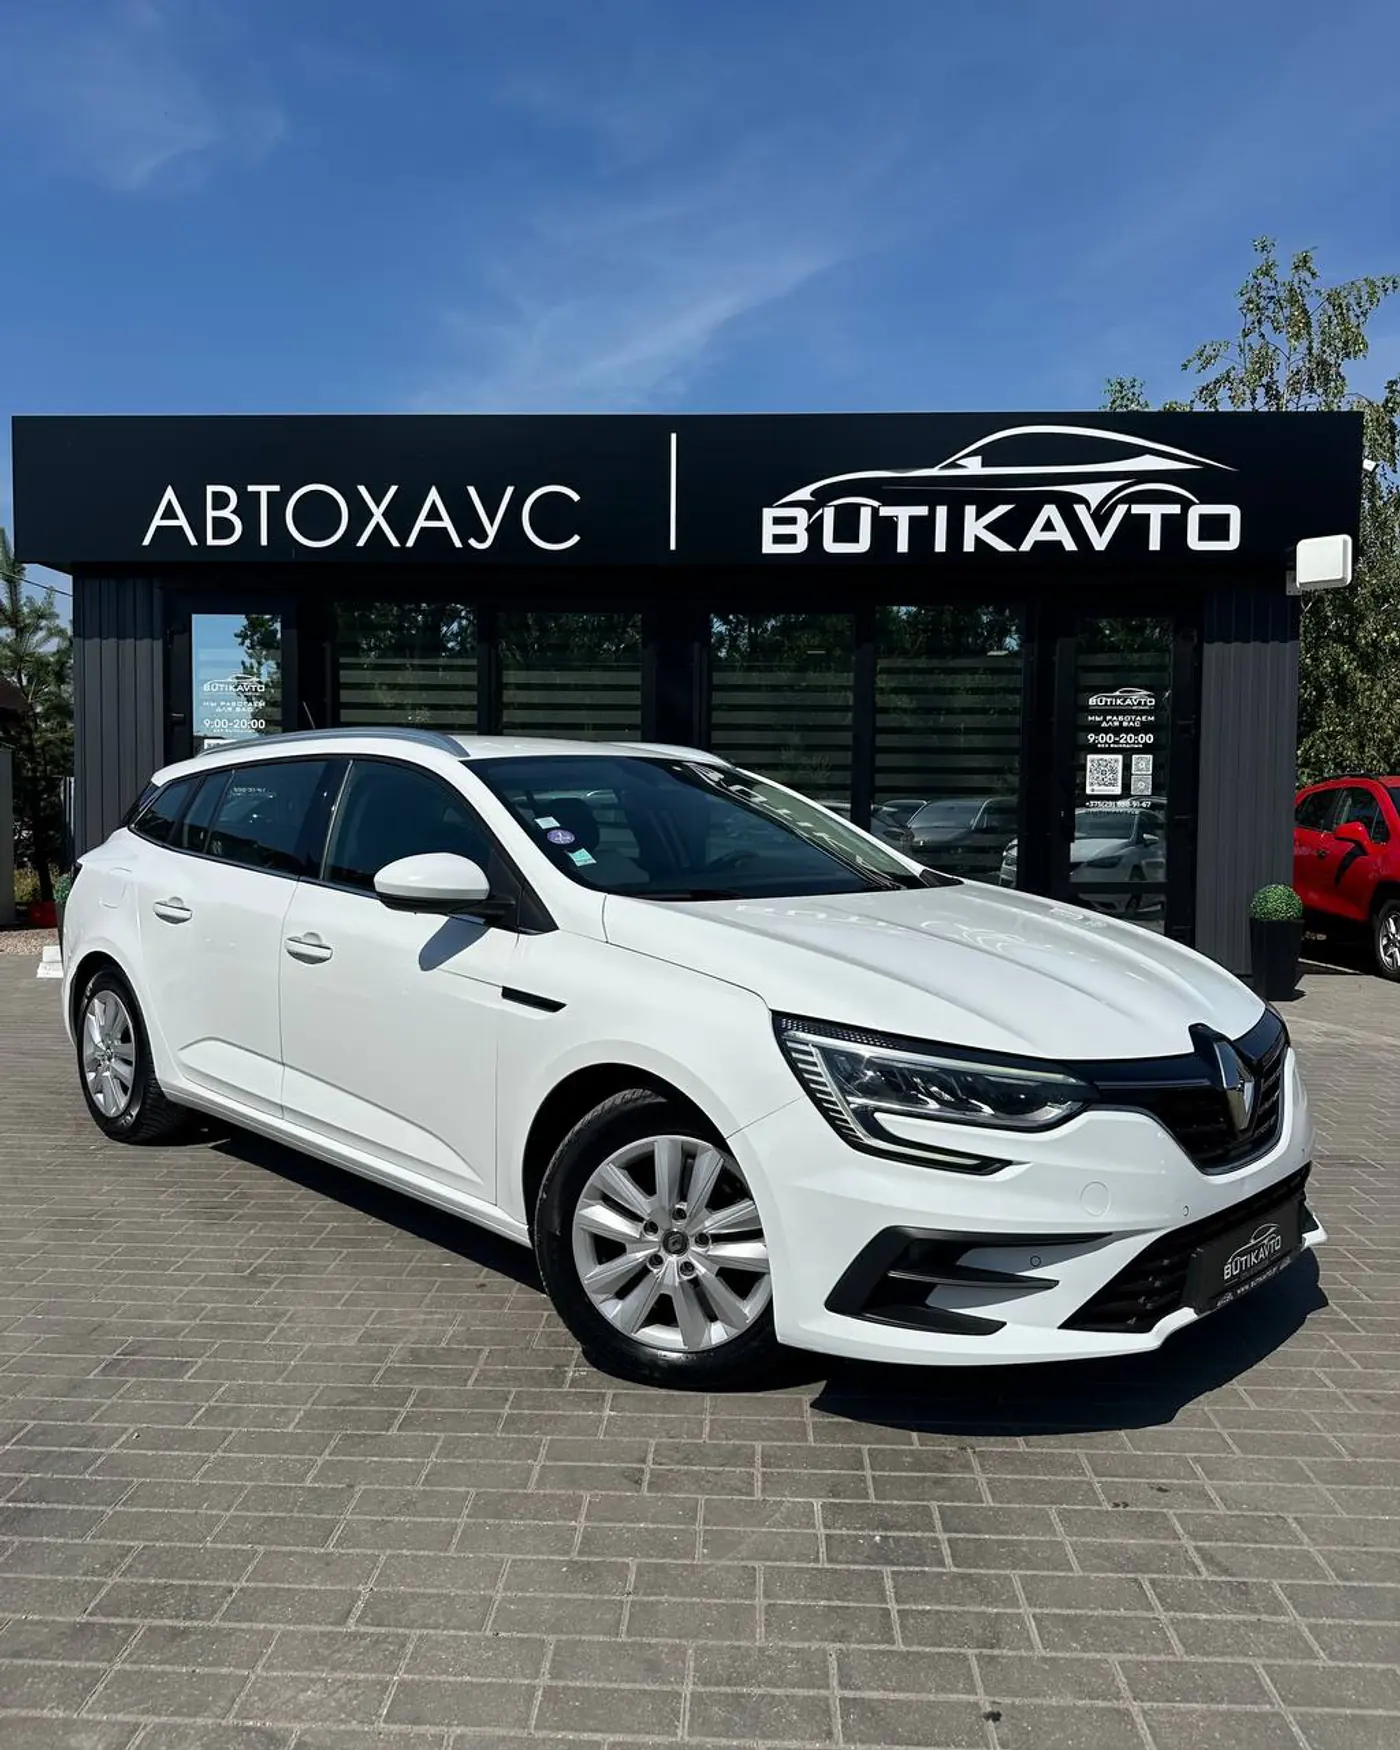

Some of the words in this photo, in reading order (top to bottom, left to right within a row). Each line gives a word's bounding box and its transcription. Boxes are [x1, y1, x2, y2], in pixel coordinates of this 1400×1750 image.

[142, 483, 581, 551] АВТОХАУС
[761, 503, 1242, 555] BUTIKAVTO
[203, 683, 265, 692] BUTIKAVTO
[1088, 697, 1156, 706] BUTIKAVTO
[203, 718, 266, 729] 9:00-20:00
[1087, 733, 1154, 744] 9:00-20:00
[1223, 1235, 1281, 1281] BUTIKAVTO
